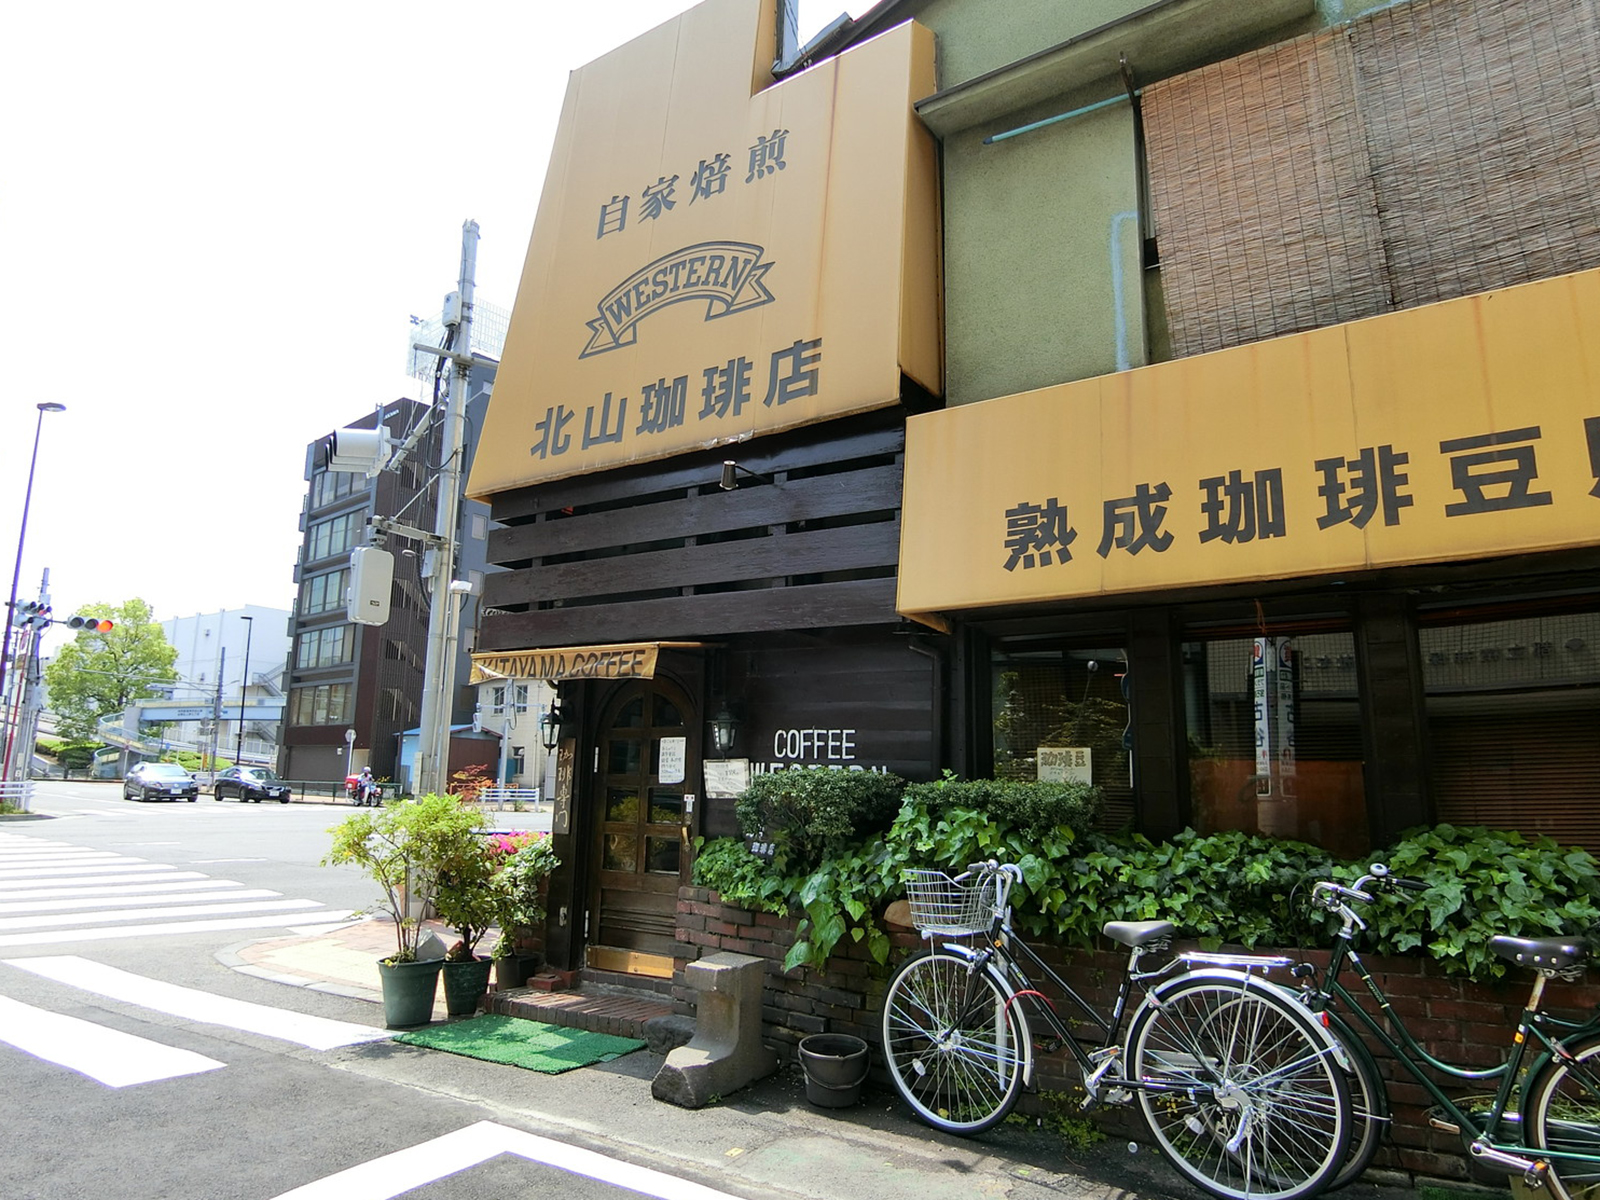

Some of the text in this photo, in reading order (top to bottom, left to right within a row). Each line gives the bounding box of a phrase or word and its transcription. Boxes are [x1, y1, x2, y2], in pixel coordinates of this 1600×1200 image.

[597, 129, 790, 240] 自家焙煎
[604, 255, 753, 326] WESTERN
[530, 338, 823, 460] 北山珈琲店
[1003, 416, 1600, 572] 熟成珈琲豆
[569, 650, 646, 677] COFFEE
[774, 728, 856, 760] COFFEE
